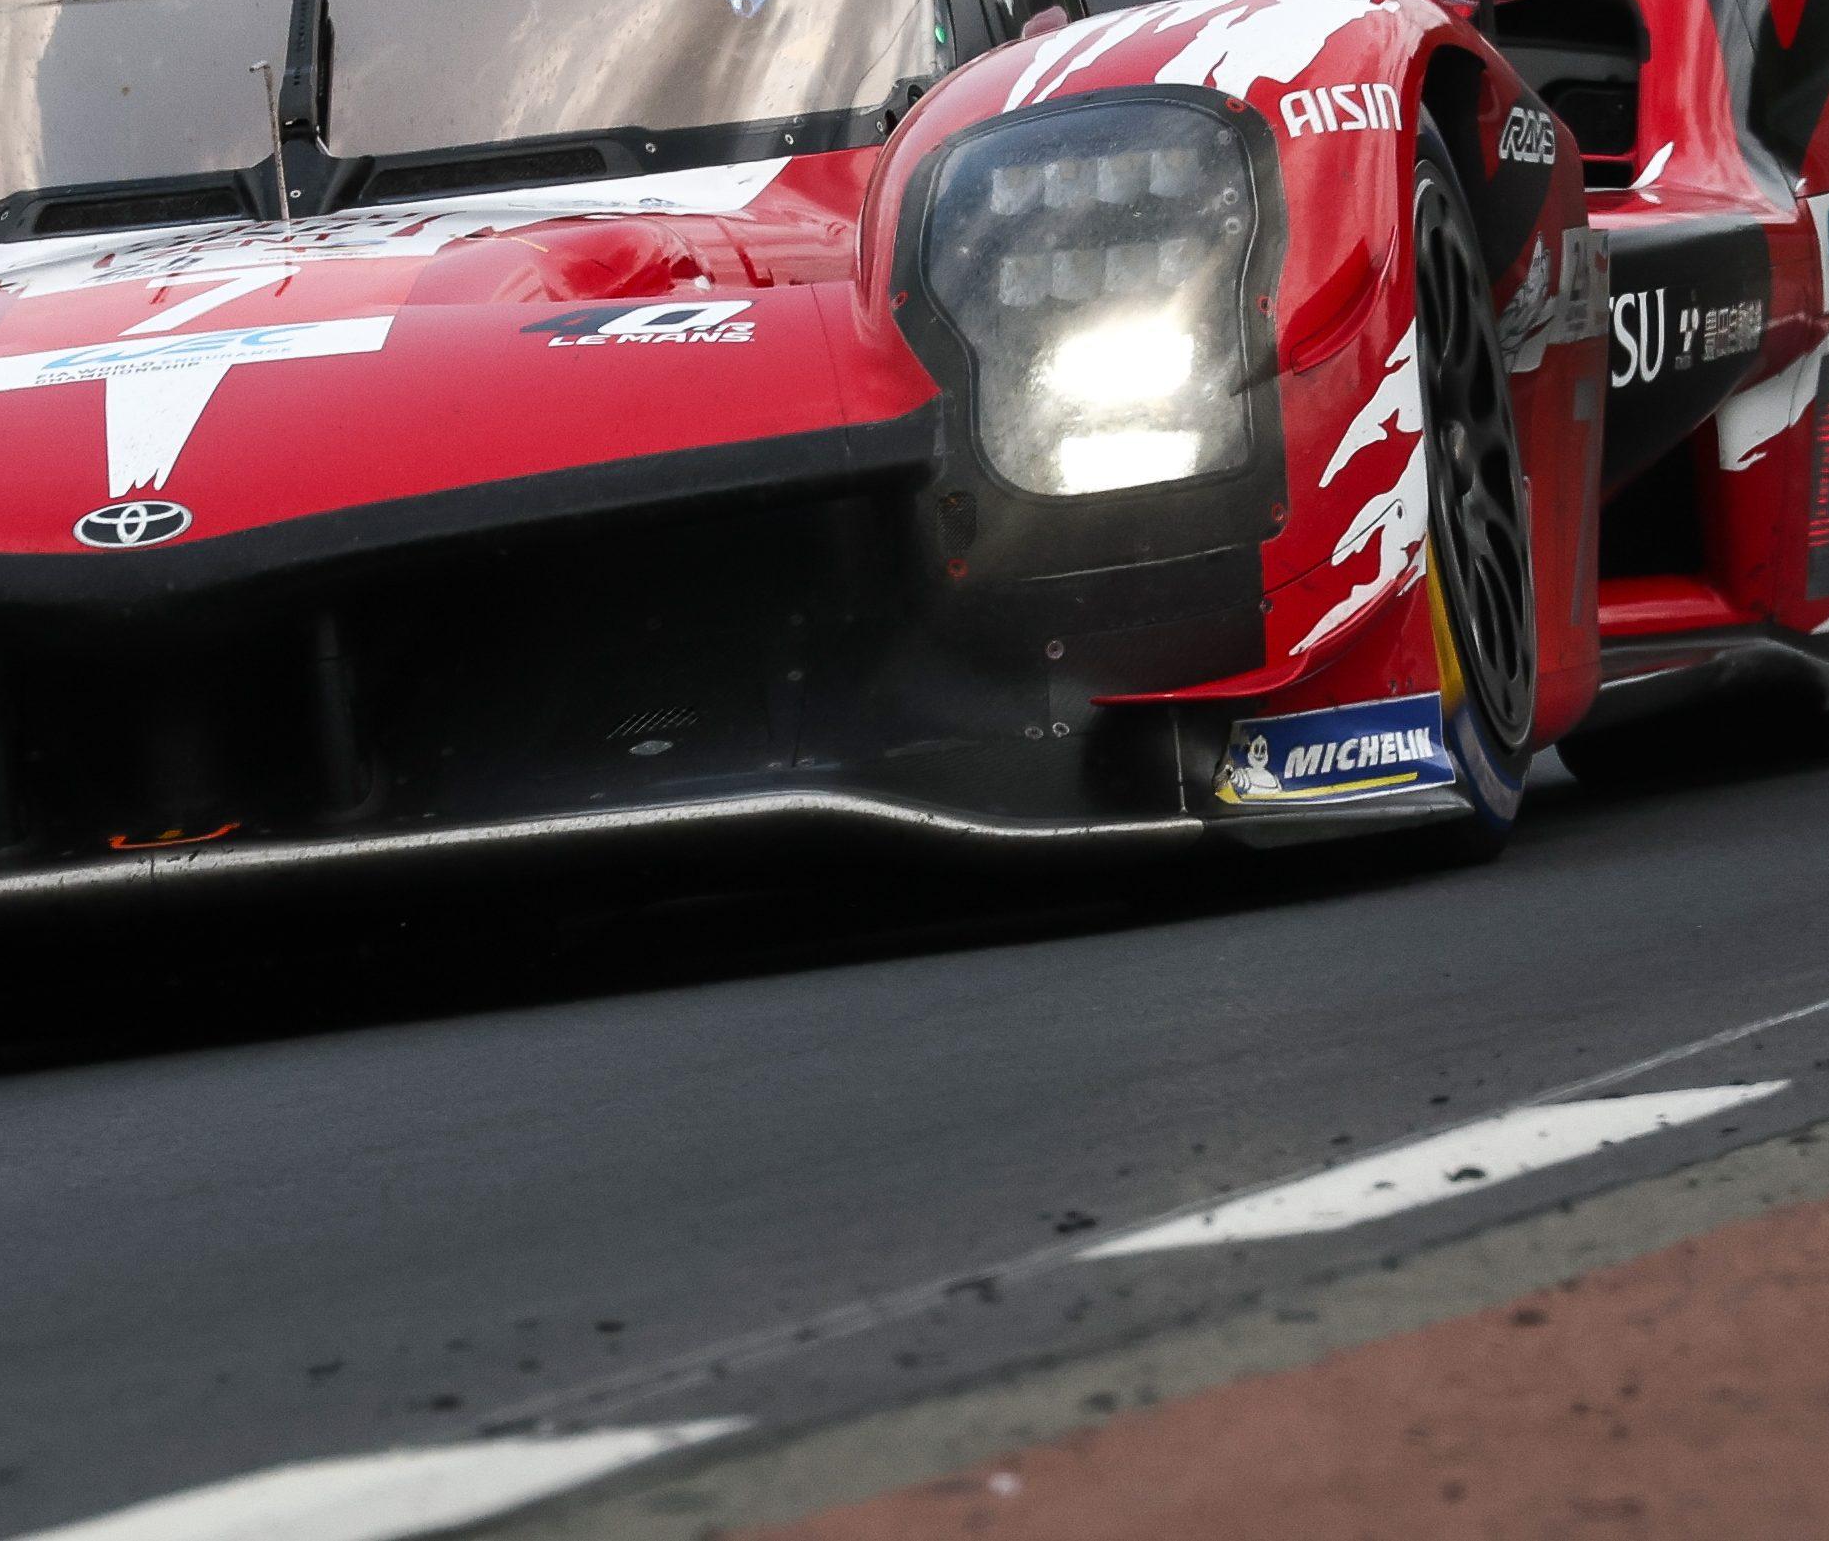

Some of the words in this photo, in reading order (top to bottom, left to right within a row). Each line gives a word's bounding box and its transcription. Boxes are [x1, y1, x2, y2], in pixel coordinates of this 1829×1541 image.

[1279, 83, 1403, 138] AISIN
[119, 265, 302, 336] 7
[616, 331, 754, 345] MANS
[1609, 287, 1667, 388] SU
[35, 361, 201, 385] CHAMPIONSHIP
[36, 369, 74, 380] FIA
[78, 361, 155, 375] WORLD
[1283, 727, 1434, 779] MICHELIN
